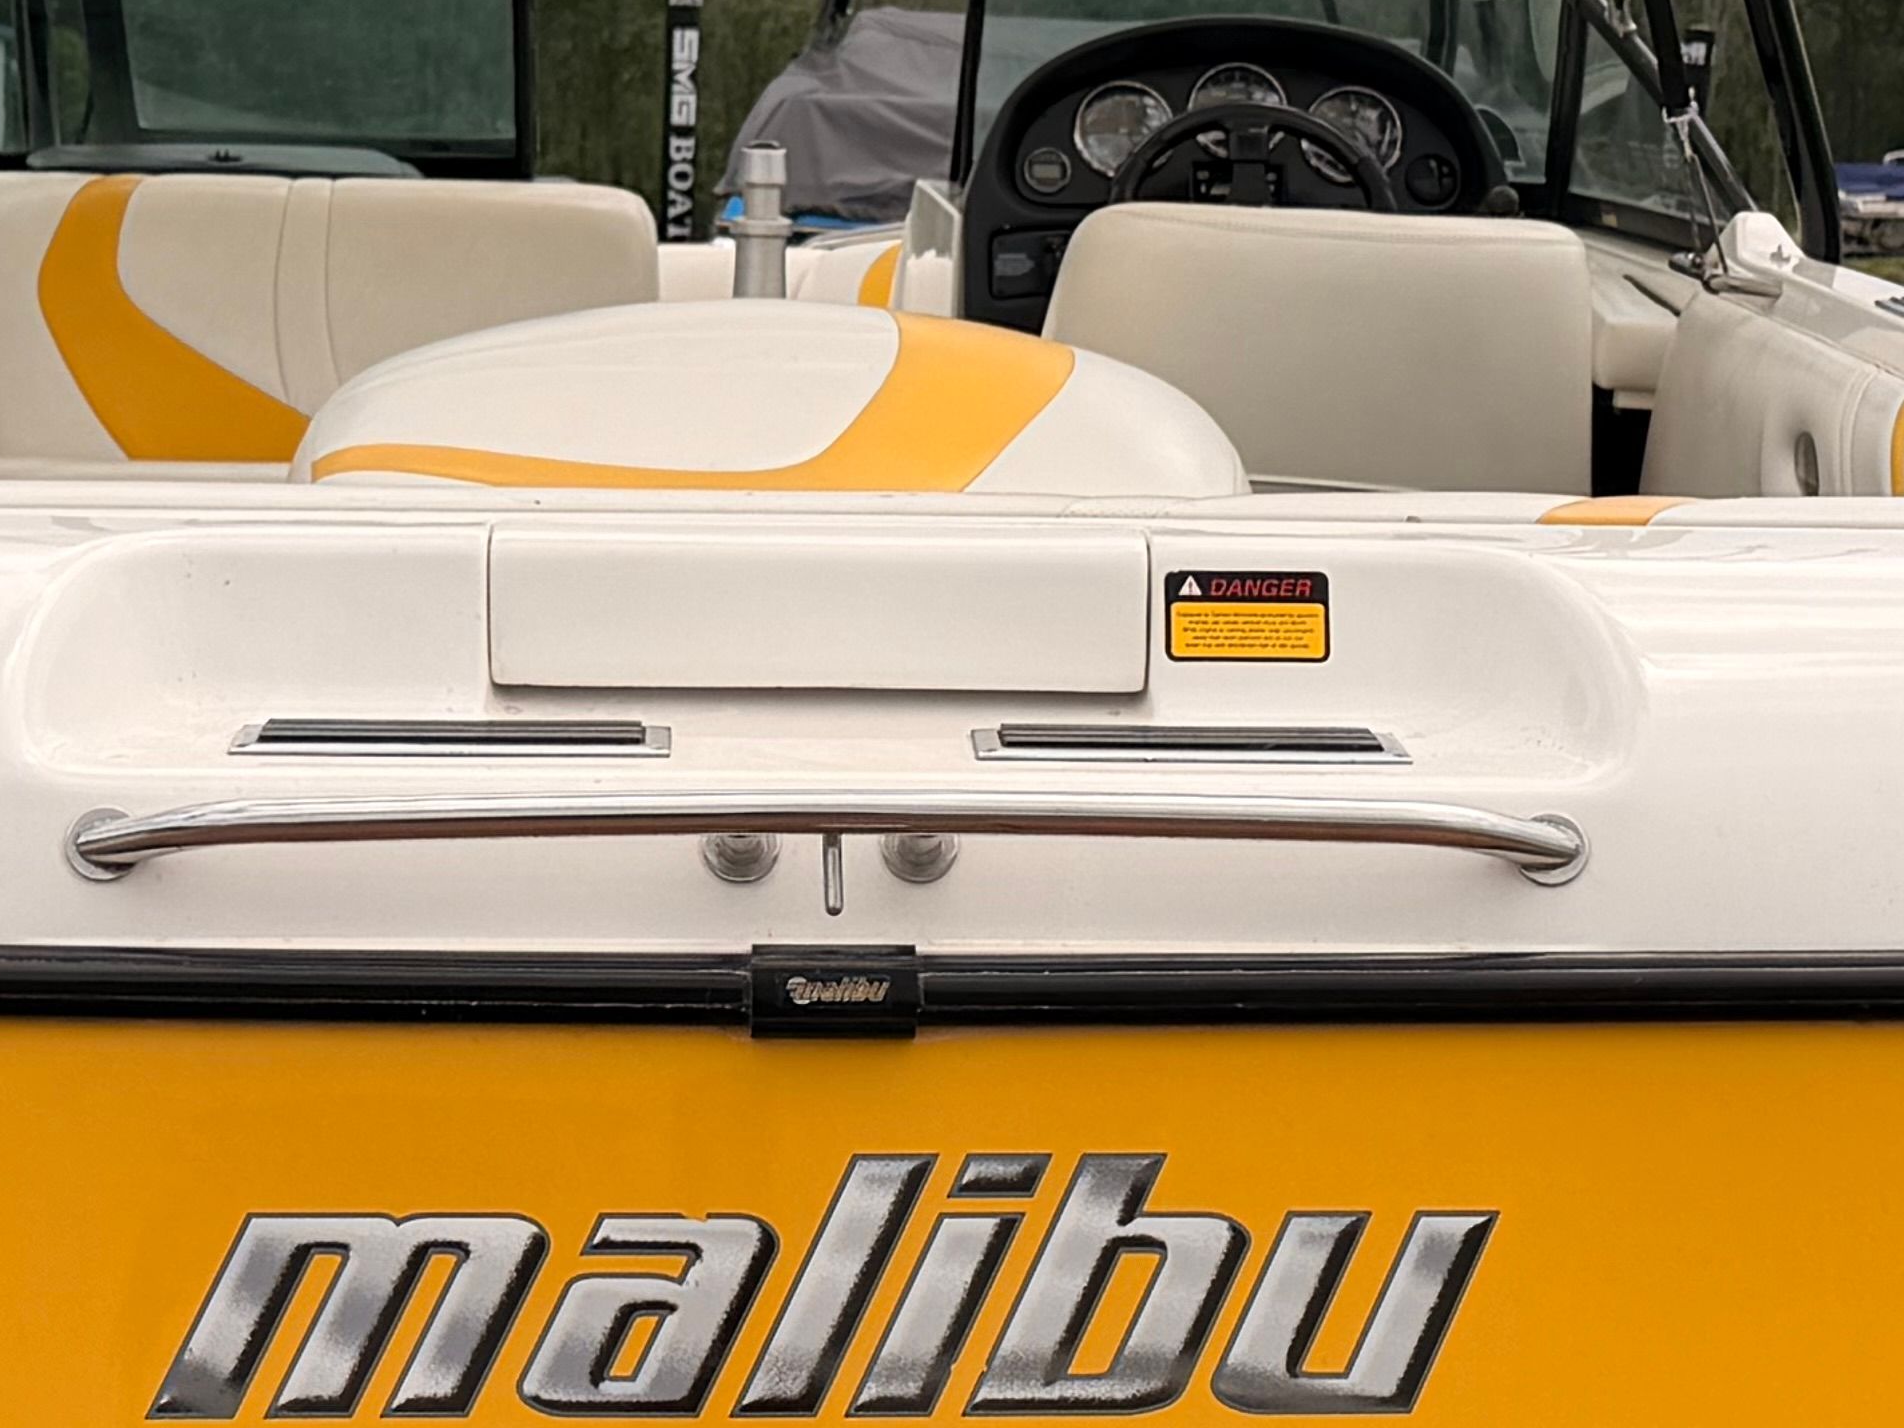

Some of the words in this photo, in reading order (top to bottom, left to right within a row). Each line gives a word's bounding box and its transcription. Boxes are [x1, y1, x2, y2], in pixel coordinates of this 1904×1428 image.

[670, 28, 700, 127] SMG
[1210, 578, 1312, 597] DANGER
[146, 1154, 1498, 1419] malibu
